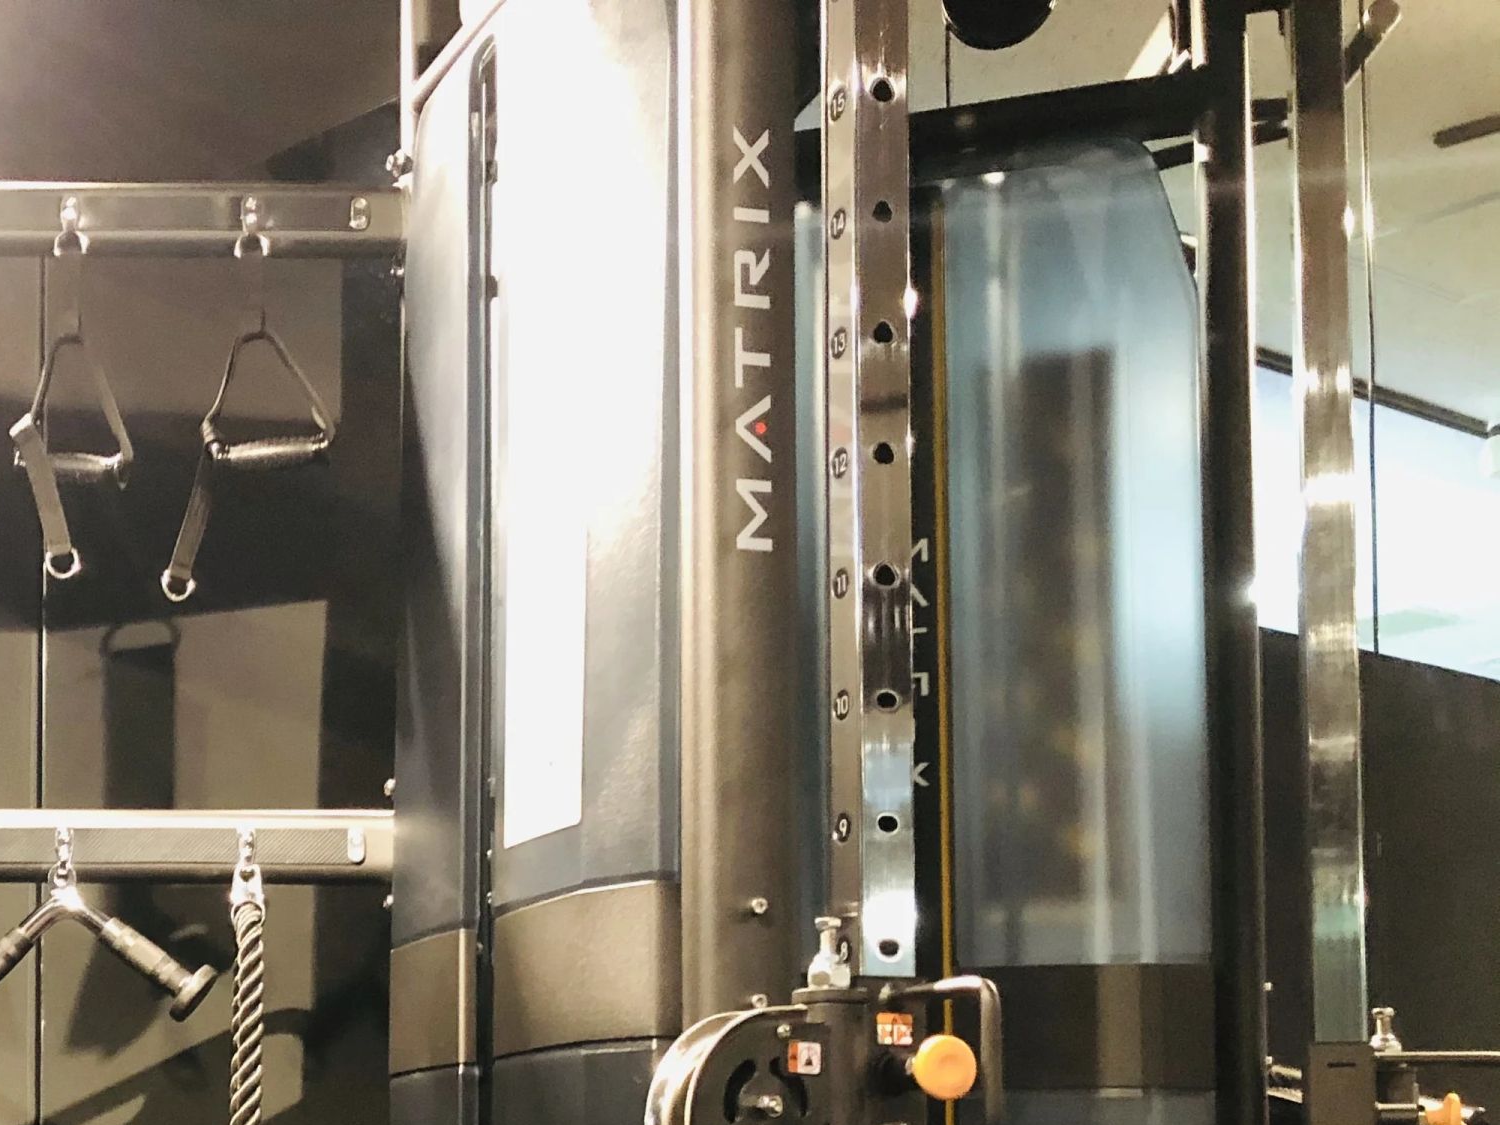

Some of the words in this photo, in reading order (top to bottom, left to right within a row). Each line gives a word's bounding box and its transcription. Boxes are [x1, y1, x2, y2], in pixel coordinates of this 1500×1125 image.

[832, 91, 845, 117] 15
[832, 211, 845, 236] 14
[733, 125, 773, 552] MATRIX
[834, 333, 847, 355] 13
[834, 453, 847, 476] 12
[836, 573, 847, 596] 11
[836, 694, 849, 716] 10
[839, 818, 848, 837] 9
